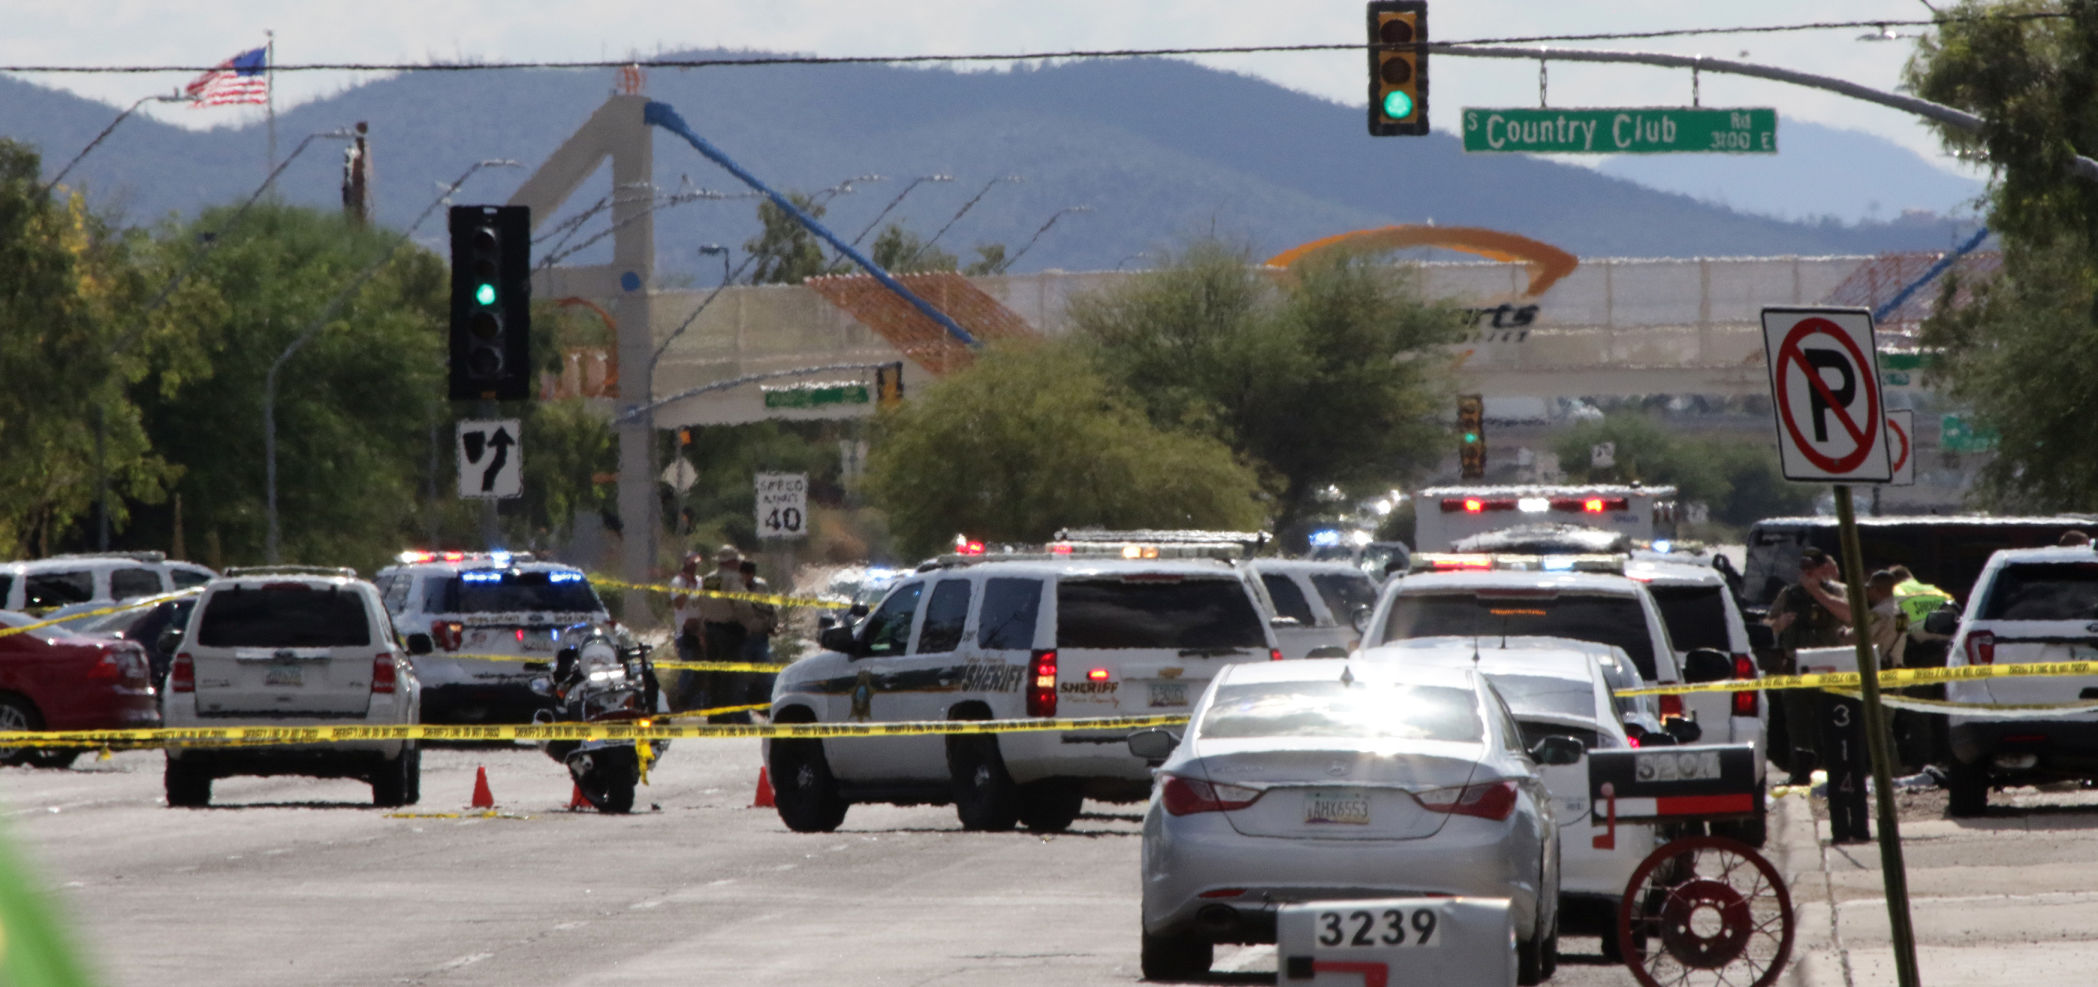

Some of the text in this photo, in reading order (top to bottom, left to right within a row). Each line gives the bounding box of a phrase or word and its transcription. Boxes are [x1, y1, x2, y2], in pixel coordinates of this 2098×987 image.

[1467, 112, 1677, 150] S Country Club
[1731, 112, 1751, 129] Rd
[1761, 132, 1773, 149] E
[765, 508, 801, 532] 40
[961, 664, 1027, 692] SHERIFF
[1060, 682, 1119, 694] SHERIFF
[1319, 908, 1438, 947] 3239
